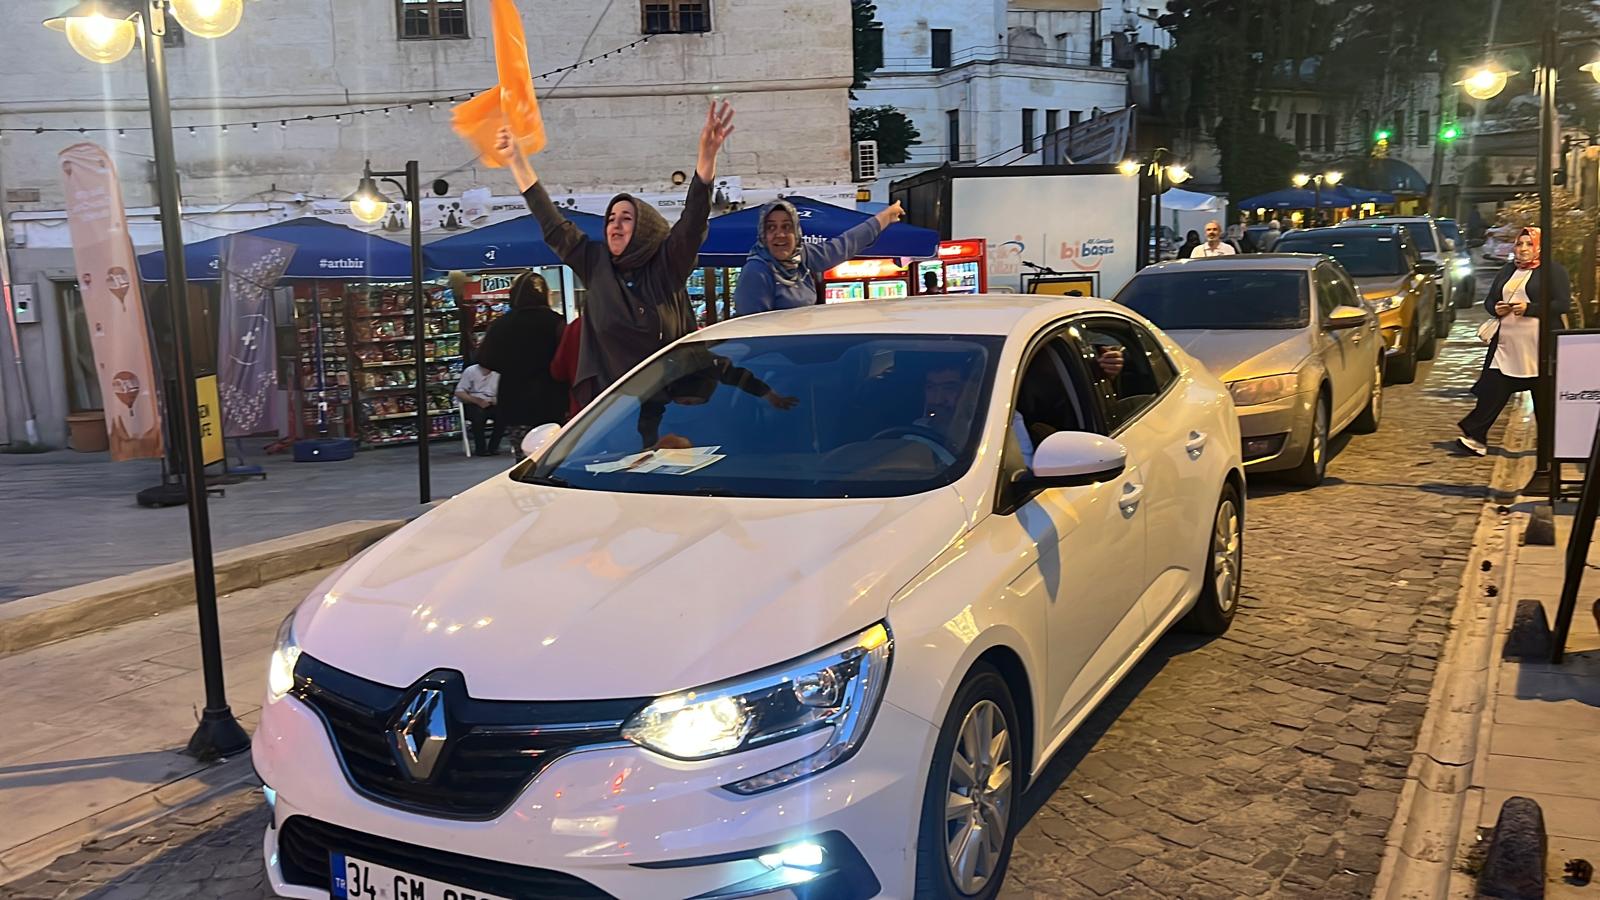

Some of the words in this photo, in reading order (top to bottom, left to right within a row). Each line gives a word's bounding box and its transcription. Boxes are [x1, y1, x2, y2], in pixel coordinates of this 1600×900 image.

[335, 877, 346, 889] TR
[347, 862, 376, 900] 34
[394, 875, 425, 900] GM
